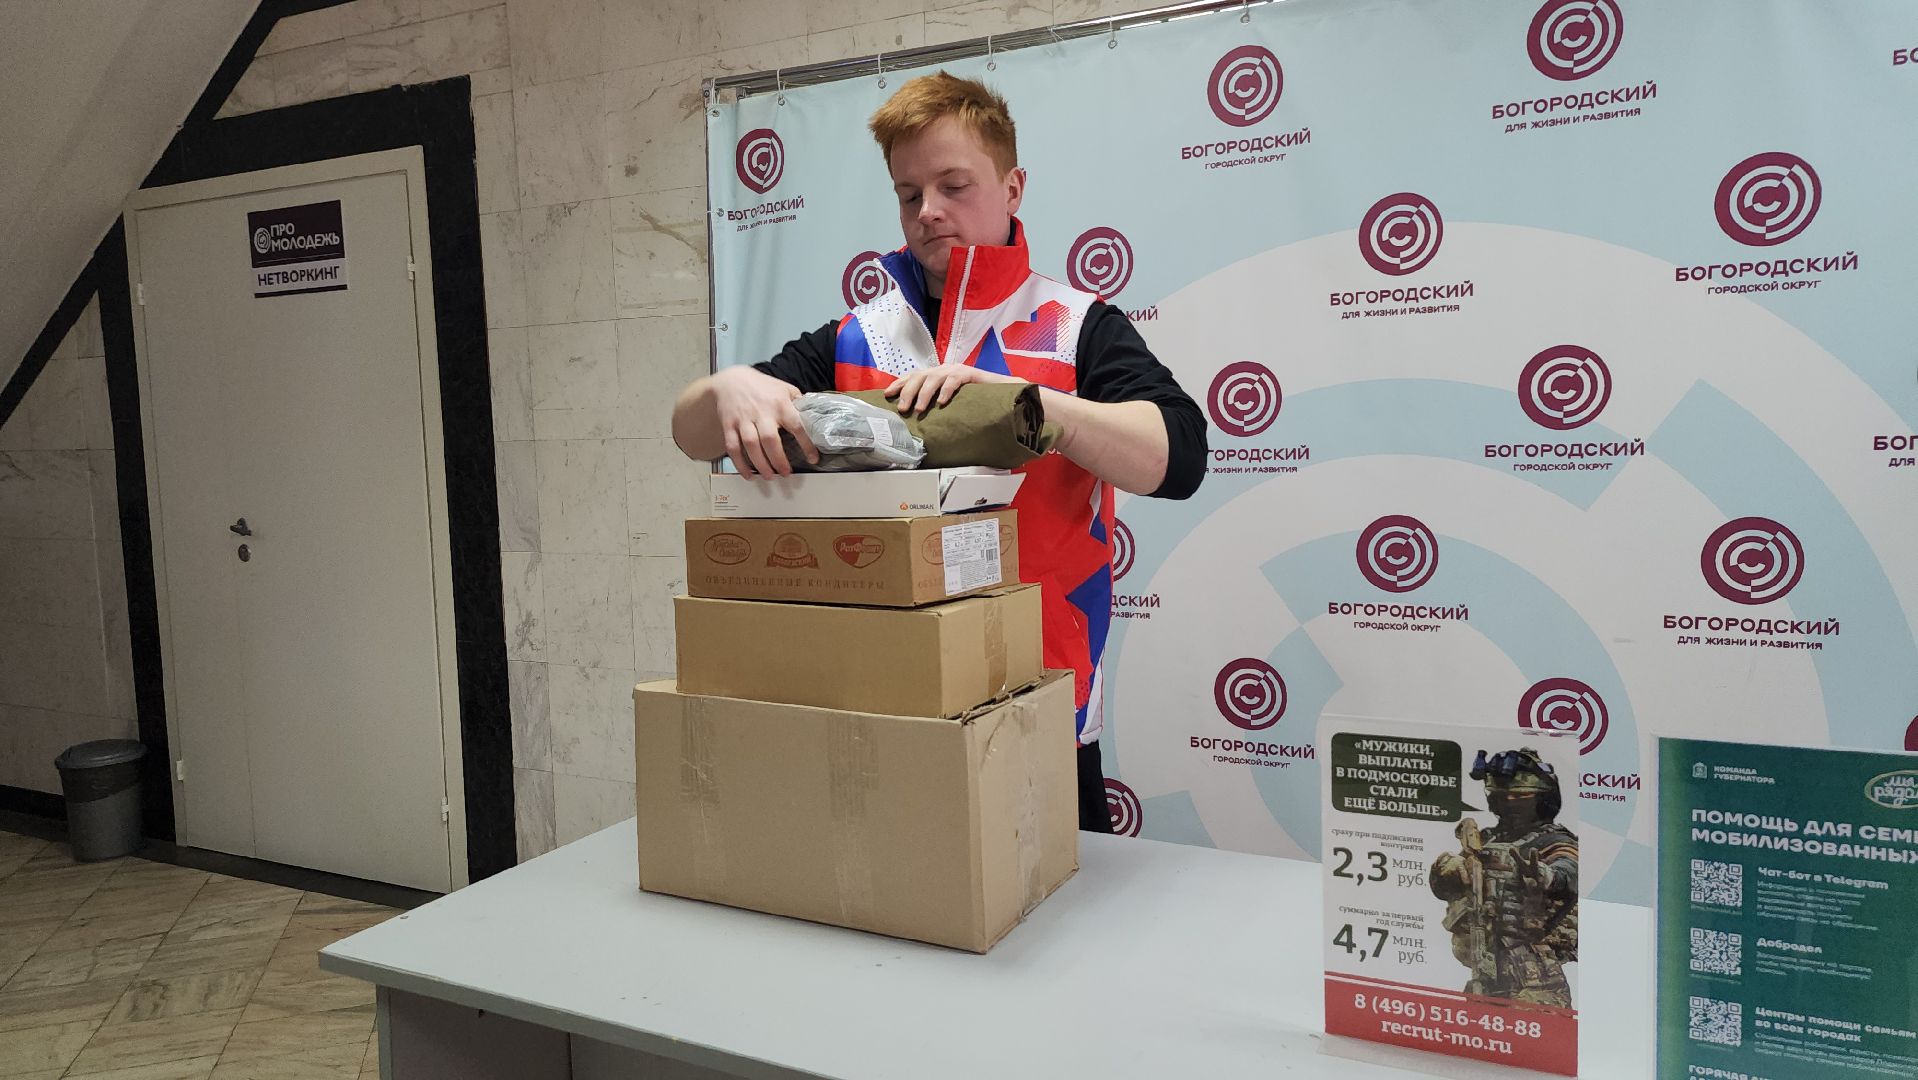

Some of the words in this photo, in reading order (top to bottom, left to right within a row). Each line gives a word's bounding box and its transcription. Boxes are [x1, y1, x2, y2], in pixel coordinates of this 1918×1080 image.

[1491, 79, 1657, 119] БОГОРОДСКИЙ
[1504, 122, 1527, 133] ДЛЯ
[1531, 117, 1570, 129] ЖИЗНИ
[1573, 116, 1580, 124] И
[1582, 108, 1641, 122] РАЗВИТИЯ
[1181, 127, 1311, 160] БОГОРОДСКИЙ
[1205, 156, 1256, 170] ГОРОДСКОЙ
[1258, 153, 1287, 164] ОКРУГ
[727, 195, 805, 221] БОГОРОДСКИЙ
[270, 222, 295, 237] ПРО
[271, 232, 340, 252] МОЛОДЕЖЬ
[1675, 251, 1859, 282] БОГОРОДСКИЙ
[257, 265, 340, 287] НЕТВОРКИНГ
[1329, 280, 1474, 306] БОГОРОДСКИЙ
[1707, 281, 1779, 295] ГОРОДСКОЙ
[1781, 280, 1822, 290] ОКРУГ
[1341, 311, 1360, 320] ДЛЯ
[1364, 309, 1398, 317] ЖИЗНИ
[1408, 304, 1460, 314] РАЗВИТИЯ
[1485, 438, 1645, 459] БОГОРОДСКИЙ
[1513, 462, 1575, 472] ГОРОДСКОЙ
[1577, 462, 1613, 471] ОКРУГ
[1888, 457, 1916, 468] ДЛЯ
[1328, 601, 1469, 621] БОГОРОДСКИЙ
[1353, 621, 1409, 631] ГОРОДСКОЙ
[1410, 624, 1441, 632] ОКРУГ
[1663, 615, 1840, 636] БОГОРОДСКИЙ
[1676, 636, 1700, 645] ДЛЯ
[1705, 637, 1747, 646] ЖИЗНИ
[1750, 639, 1758, 647] И
[1760, 640, 1823, 650] РАЗВИТИЯ
[1190, 736, 1315, 760] БОГОРОДСКИЙ
[1354, 740, 1436, 757] «МУЖИКИ,
[1213, 755, 1263, 766] ГОРОДСКОЙ
[1263, 760, 1291, 769] ОКРУГ
[1358, 754, 1433, 771] ВЫПЛАТЫ
[1713, 766, 1758, 775] КОМАНДА
[1336, 766, 1345, 777] В
[1347, 768, 1457, 788] ПОДМОСКОВЬЕ
[1713, 774, 1776, 785] ГУБЕРНАТОРА
[1369, 784, 1418, 799] СТАЛИ
[1579, 791, 1626, 802] АЗВИТИЯ
[1344, 796, 1376, 811] ЕЩЁ
[1379, 800, 1449, 816] БОЛЬШЕ»
[1691, 809, 1799, 833] ПОМОЩЬ
[1803, 820, 1852, 838] ДЛЯ
[1331, 828, 1354, 837] сразу
[1333, 847, 1388, 886] 2,3
[1398, 873, 1427, 887] руб.
[1824, 873, 1889, 890] Telegram
[1376, 918, 1390, 927] год
[1333, 923, 1389, 962] 4,7
[1398, 950, 1428, 965] руб.
[1354, 993, 1366, 1009] 8
[1372, 996, 1426, 1022] (496)
[1430, 1006, 1541, 1039] 516-48-88
[1808, 1016, 1862, 1031] помощи
[1380, 1020, 1513, 1055] recrut-mo.ru
[1807, 1027, 1862, 1042] городах
